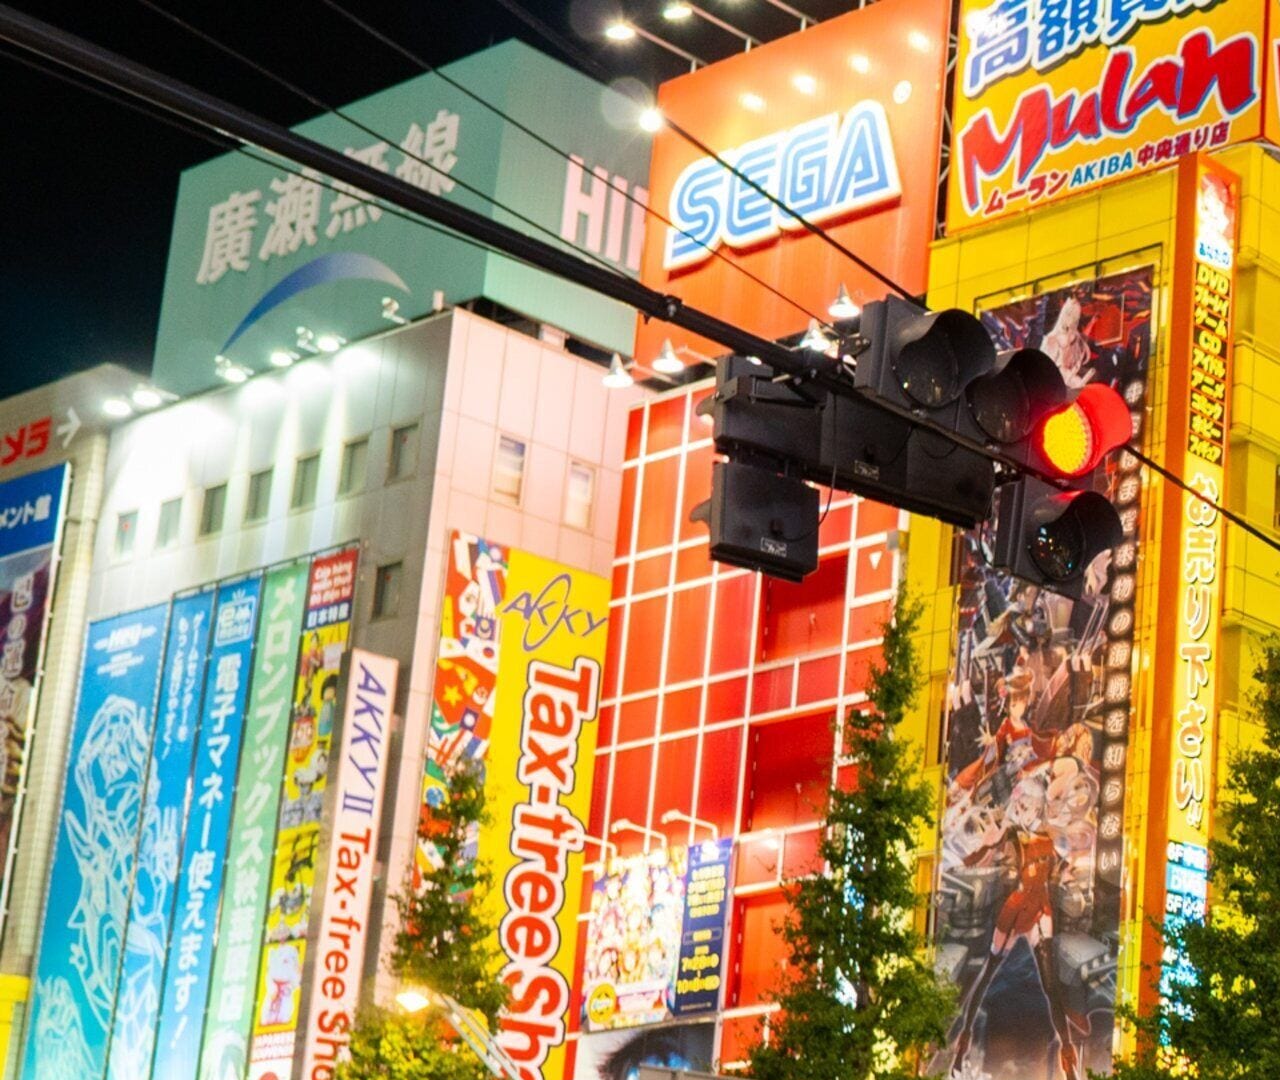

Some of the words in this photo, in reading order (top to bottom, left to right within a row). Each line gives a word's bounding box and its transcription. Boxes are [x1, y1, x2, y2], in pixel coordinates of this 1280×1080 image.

[961, 31, 1258, 212] Mulan
[984, 171, 1069, 216] ムーラン
[1071, 151, 1133, 188] AKIBA
[1136, 121, 1232, 167] 中央通り店
[663, 99, 902, 270] SEGA
[1197, 265, 1229, 296] DVD
[1191, 370, 1225, 401] アニメ
[1198, 329, 1223, 356] CD
[502, 578, 609, 649] AKKY
[345, 663, 389, 782] AKKY
[503, 658, 600, 964] Tax-free
[321, 826, 372, 999] Tax-free
